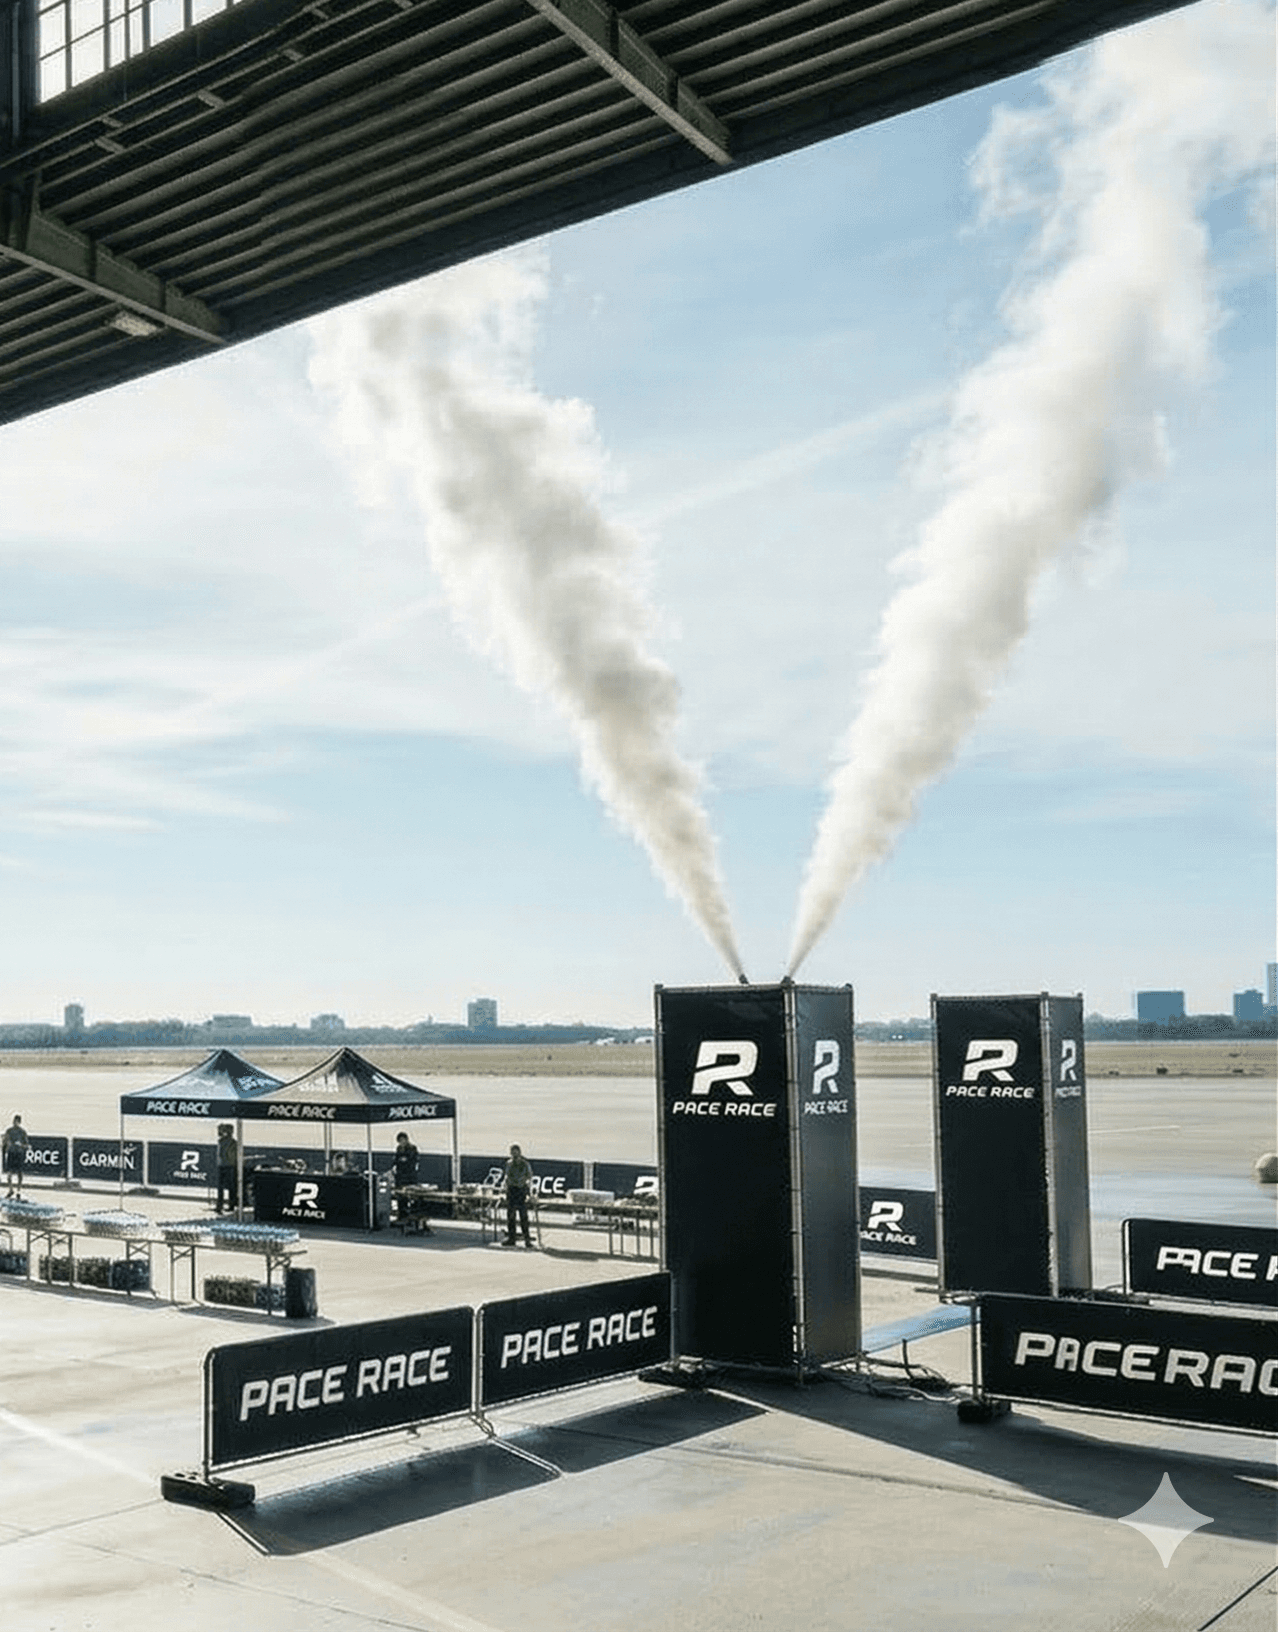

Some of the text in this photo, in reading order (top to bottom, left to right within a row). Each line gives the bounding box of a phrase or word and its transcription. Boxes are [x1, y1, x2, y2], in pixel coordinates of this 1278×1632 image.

[691, 1041, 759, 1096] R
[812, 1040, 840, 1095] R
[962, 1040, 1018, 1082] R
[945, 1085, 1035, 1098] PACE RACE
[146, 1101, 211, 1114] PACE RACE
[267, 1105, 301, 1117] PACE
[672, 1102, 778, 1117] PACE RACE
[25, 1150, 60, 1165] RACE
[79, 1152, 135, 1170] GARMIN
[180, 1150, 200, 1171] R
[292, 1182, 319, 1209] R
[530, 1175, 566, 1195] ACE
[867, 1201, 904, 1232] R
[860, 1230, 883, 1242] ACE
[1156, 1246, 1236, 1280] PACE
[499, 1306, 659, 1369] PACE RACE
[238, 1346, 453, 1422] PACE RACE
